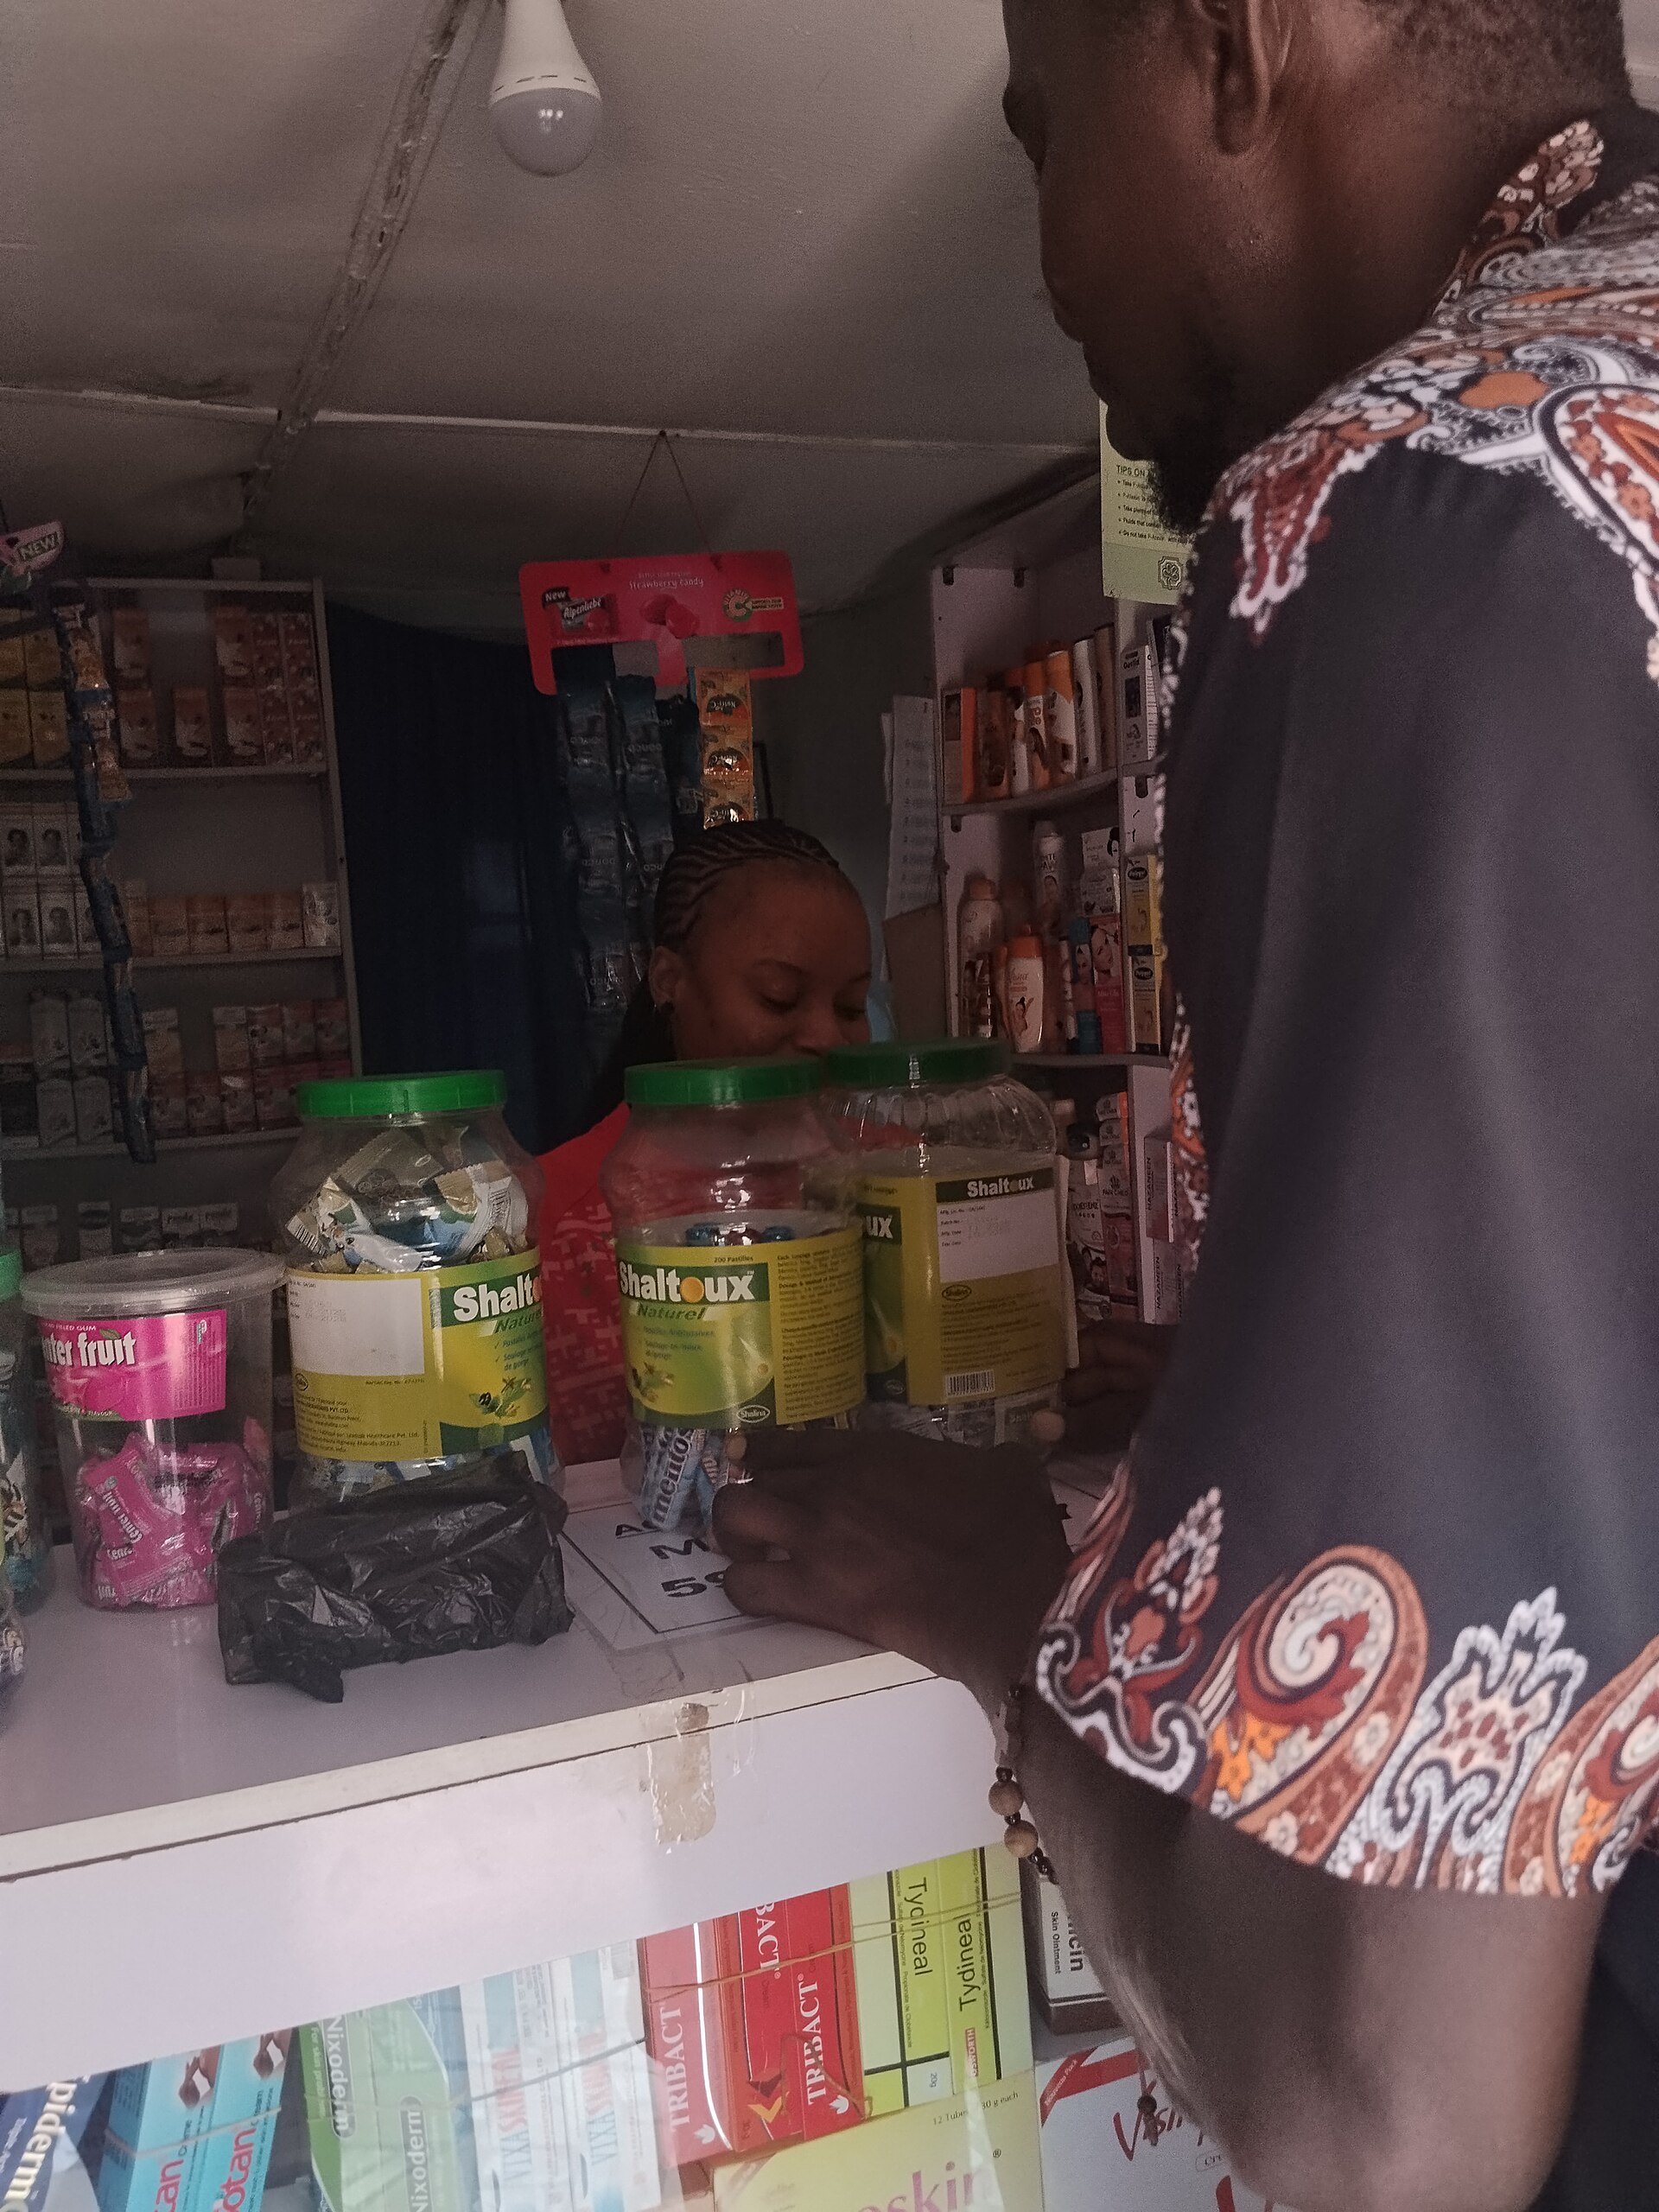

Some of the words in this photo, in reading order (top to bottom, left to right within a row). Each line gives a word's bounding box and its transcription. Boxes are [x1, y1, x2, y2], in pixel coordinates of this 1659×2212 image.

[544, 589, 567, 603] New
[967, 1176, 1034, 1198] Shaltoux
[619, 1261, 755, 1303] Shaltoux
[636, 1301, 707, 1321] Naturel
[76, 1331, 137, 1367] fruit
[904, 1876, 934, 1976] Tydineal
[1051, 1910, 1059, 1930] Skin
[1052, 1933, 1061, 1974] Ointment
[798, 1980, 827, 2107] TRIBACT
[325, 2015, 350, 2132] Nixoderm
[659, 2005, 691, 2133] TRIBACT
[999, 2091, 1020, 2104] each
[154, 2158, 185, 2212] an
